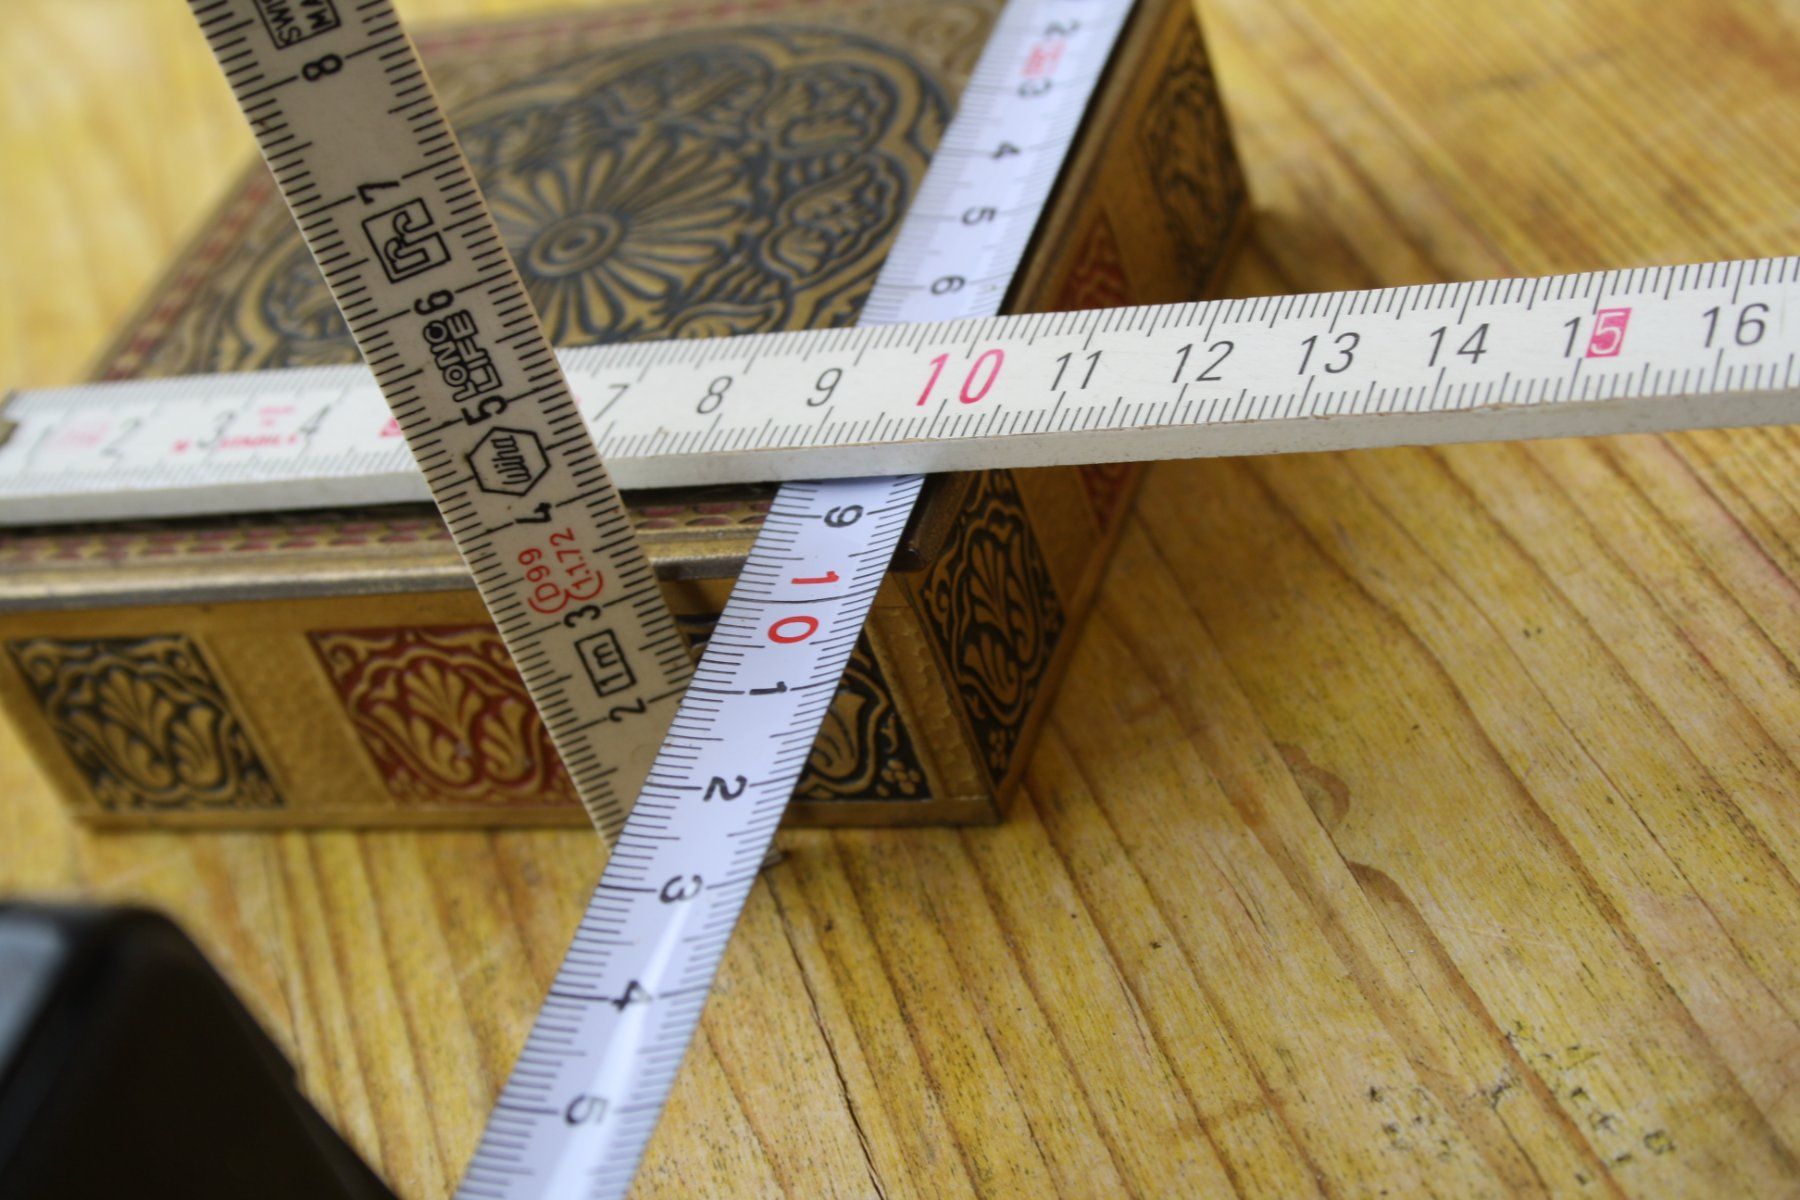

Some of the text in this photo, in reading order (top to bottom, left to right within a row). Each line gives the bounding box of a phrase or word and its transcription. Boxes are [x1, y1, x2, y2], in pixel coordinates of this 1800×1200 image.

[992, 141, 1021, 160] 4
[961, 206, 998, 226] 5
[930, 274, 966, 296] 6
[422, 319, 480, 403] LONG
[444, 309, 503, 394] LIFE
[592, 384, 630, 422] 7
[696, 375, 734, 414] 8
[807, 367, 843, 407] 9
[915, 348, 1005, 407] 10
[1051, 350, 1103, 391] 11
[1171, 340, 1235, 384] 12
[1297, 331, 1361, 376] 13
[1428, 322, 1490, 367] 14
[1563, 310, 1628, 358] 15
[1701, 302, 1770, 349] 16
[301, 53, 646, 722] 2 3 4 5 6 7 8
[490, 435, 532, 485] Wiha
[824, 504, 864, 528] 9
[518, 548, 561, 602] D99
[749, 681, 788, 695] 1
[703, 774, 748, 801] 2
[659, 874, 702, 904] 3
[612, 980, 654, 1013] 4
[565, 1094, 609, 1127] 5
